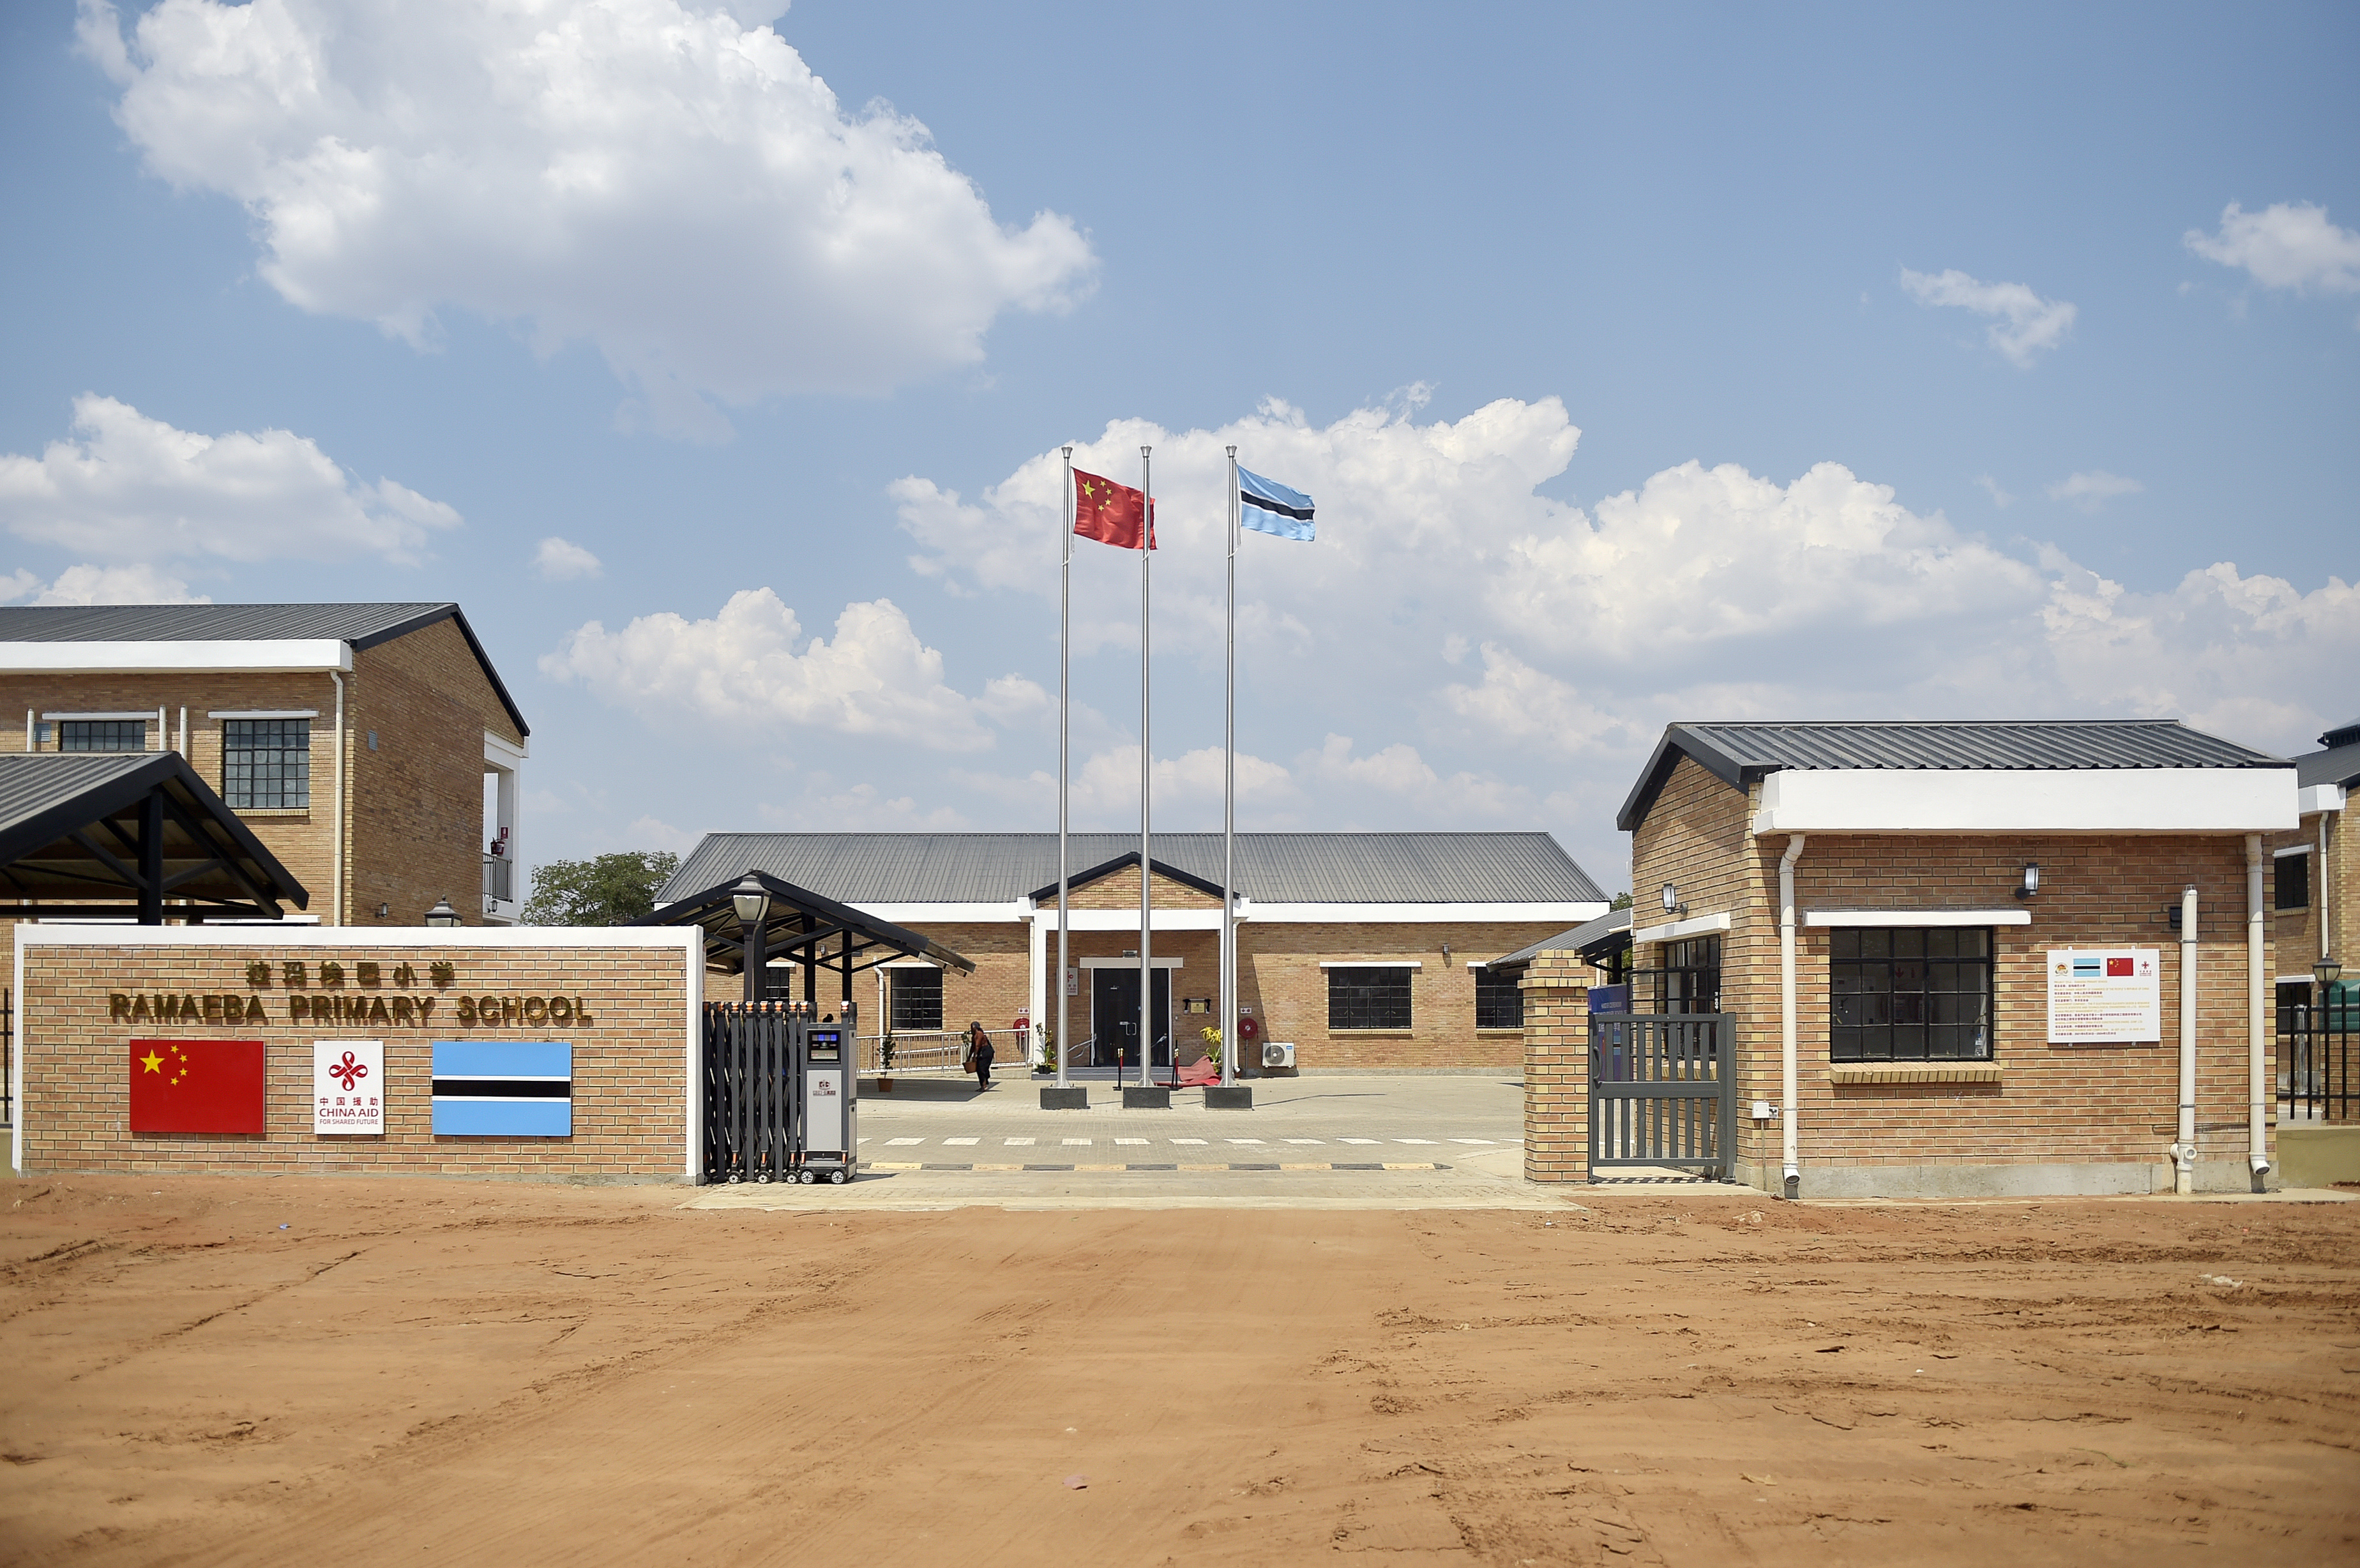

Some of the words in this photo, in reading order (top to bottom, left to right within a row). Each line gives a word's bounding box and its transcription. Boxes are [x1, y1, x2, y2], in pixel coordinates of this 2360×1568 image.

[110, 994, 266, 1018] RAMAEBA
[291, 995, 434, 1020] PRIMARY
[457, 996, 592, 1020] SCHOOL
[320, 1097, 378, 1106] 中国援助
[319, 1108, 356, 1117] CHINA
[358, 1108, 379, 1117] AID
